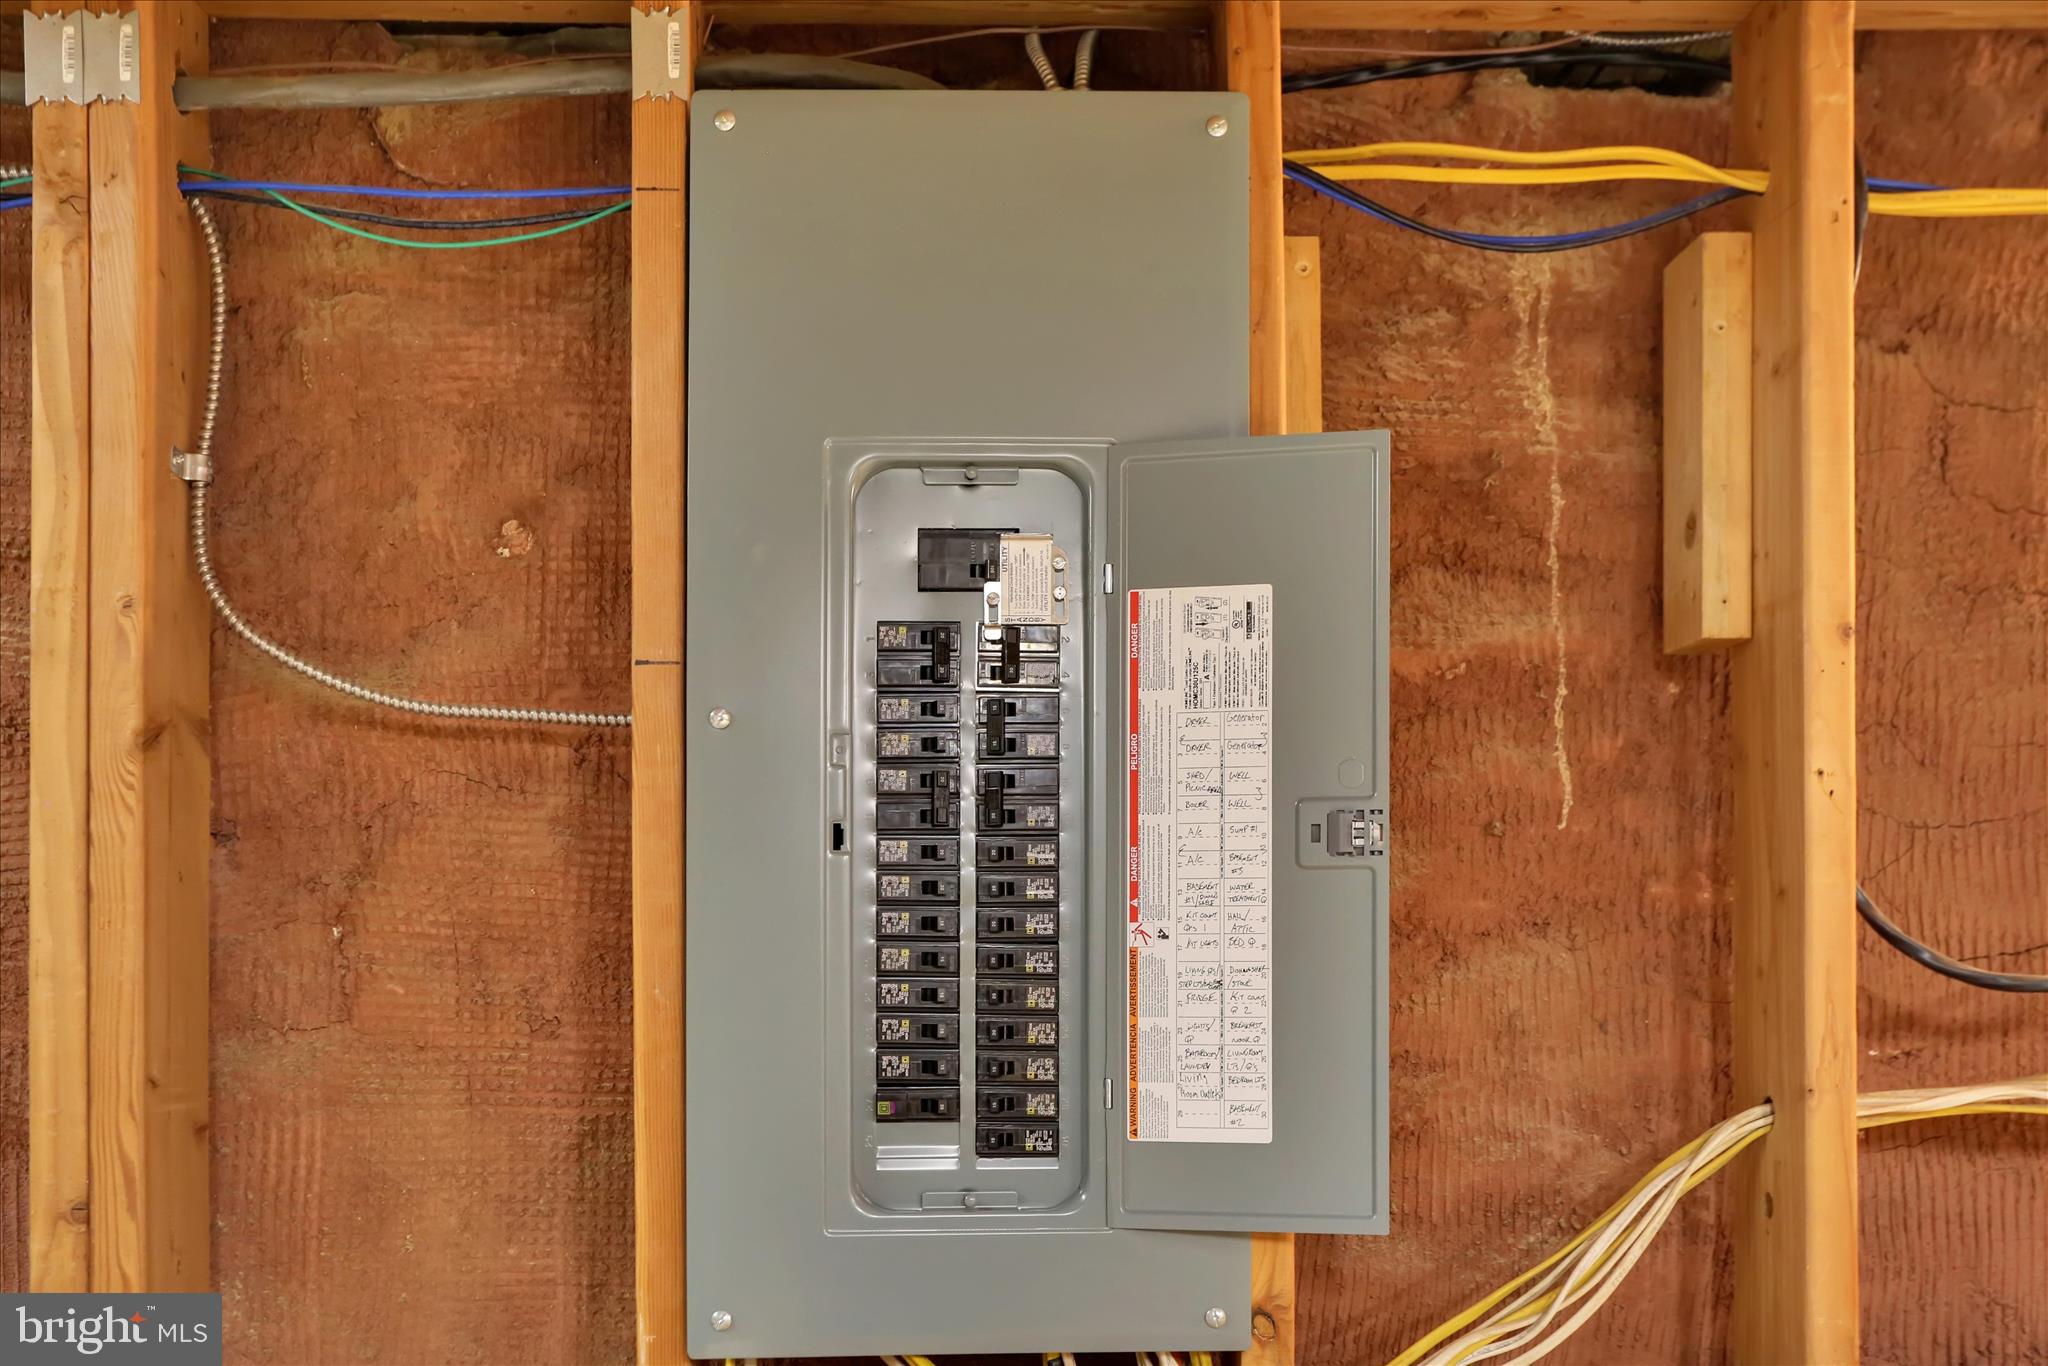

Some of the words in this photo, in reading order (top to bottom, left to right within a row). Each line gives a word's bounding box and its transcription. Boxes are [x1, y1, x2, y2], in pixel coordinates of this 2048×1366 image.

[1226, 713, 1264, 722] Generator
[1229, 772, 1251, 780] WELL
[1188, 825, 1202, 838] A/C
[1230, 825, 1248, 834] SUMP
[1187, 853, 1204, 864] A/C
[1187, 881, 1219, 891] BASEMENT
[1230, 882, 1254, 891] WATER
[1231, 923, 1256, 932] ATTIC
